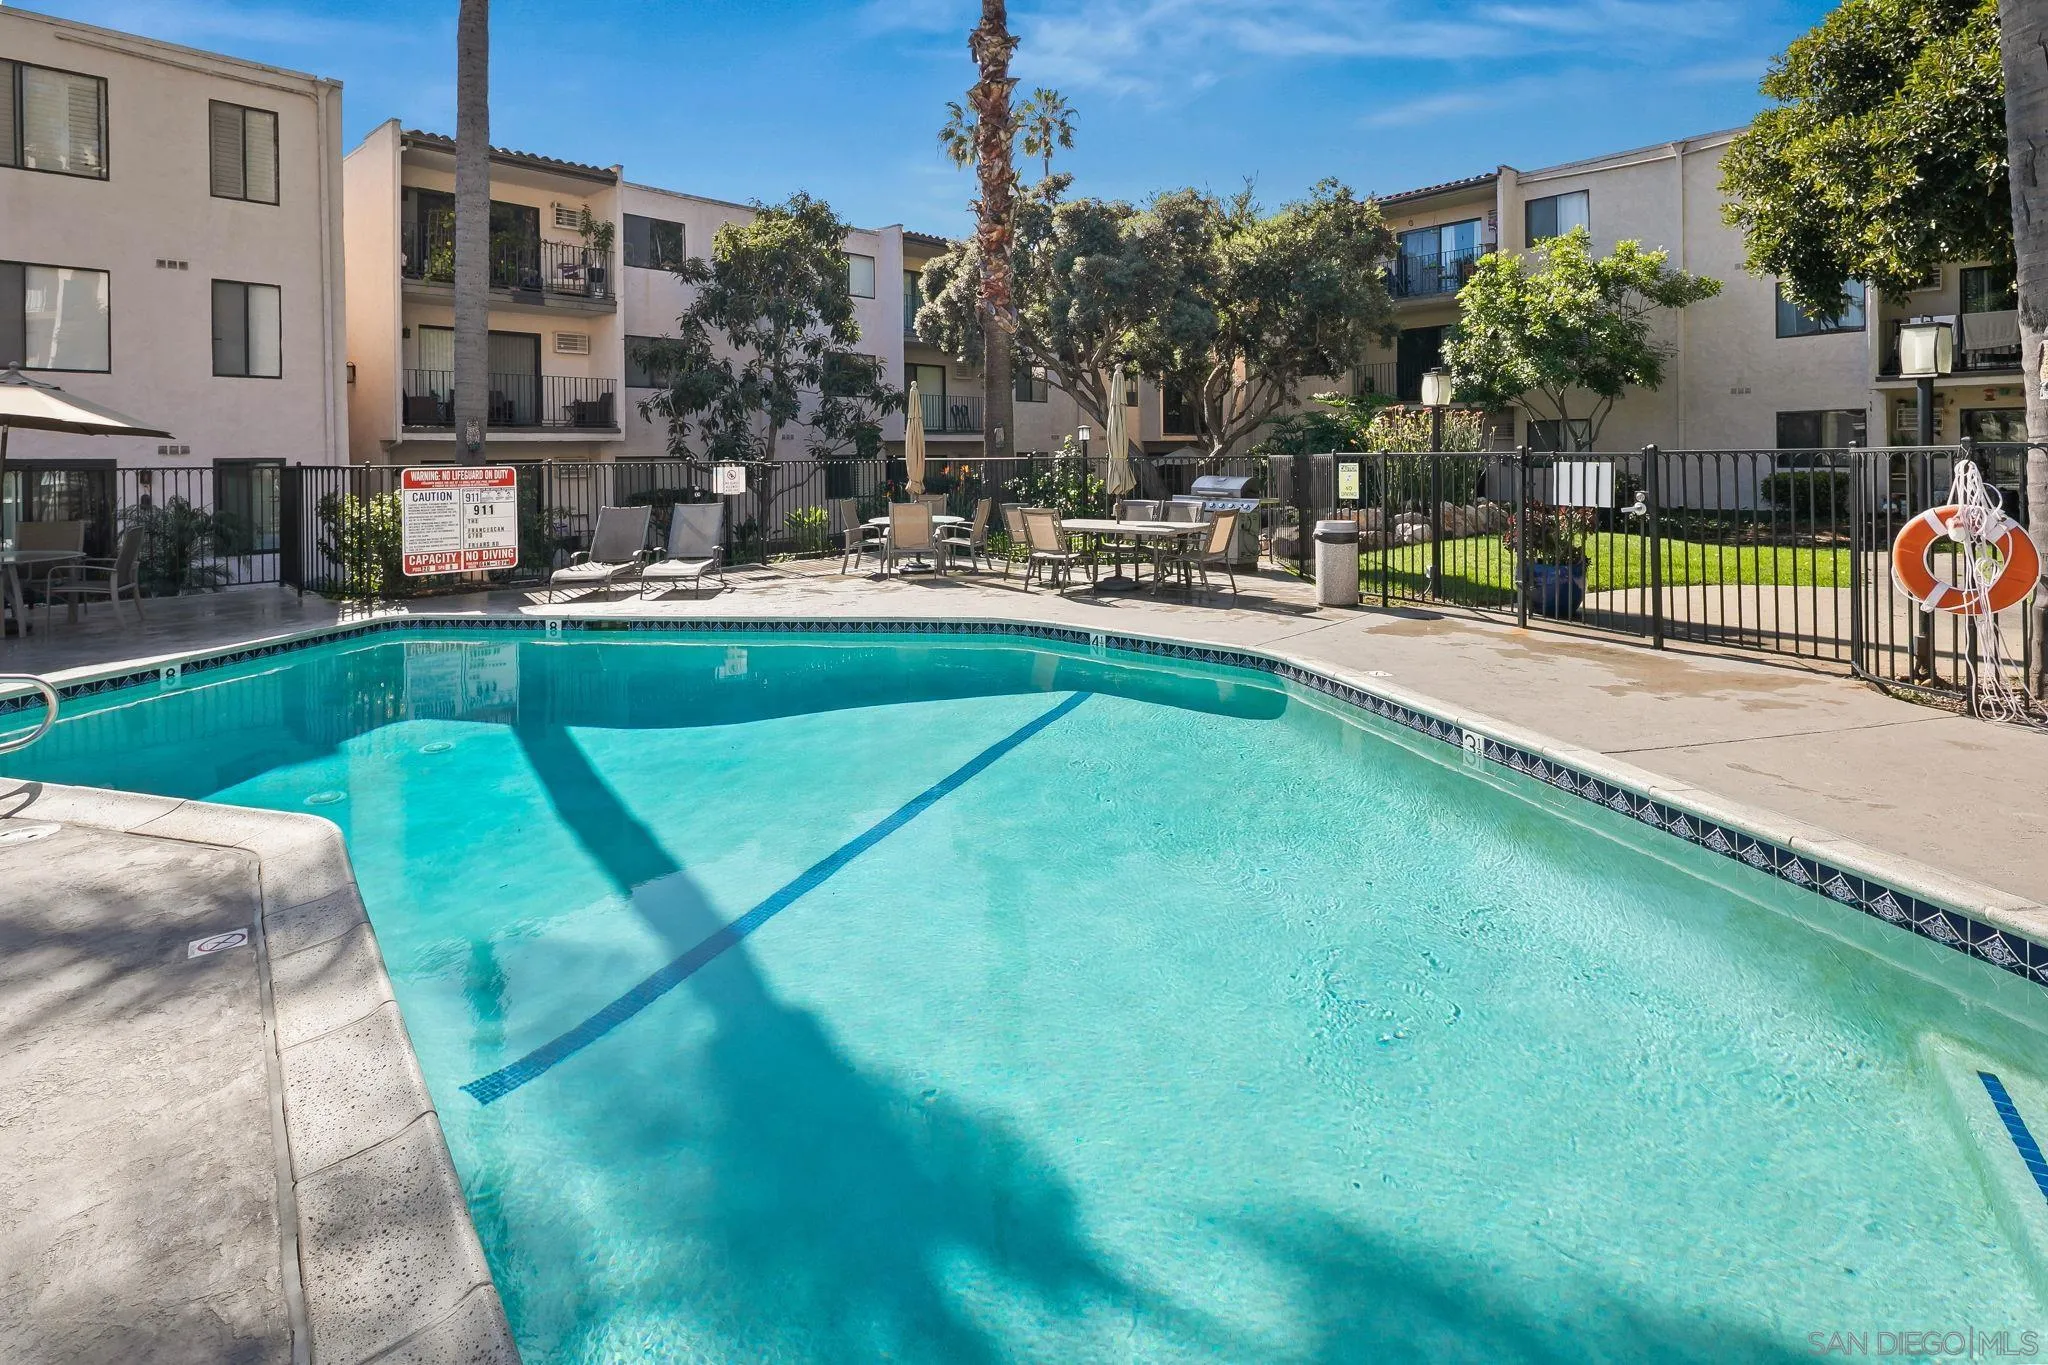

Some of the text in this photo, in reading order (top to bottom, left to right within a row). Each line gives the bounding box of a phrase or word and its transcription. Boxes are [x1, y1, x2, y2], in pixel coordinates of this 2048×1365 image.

[410, 469, 509, 481] WARNING: NO LIFEGUARD ON DUTY
[412, 491, 453, 502] CAUTION
[465, 493, 479, 502] 911
[473, 504, 494, 515] 911
[409, 552, 457, 566] CAPACITY
[465, 548, 514, 561] NO DIVING
